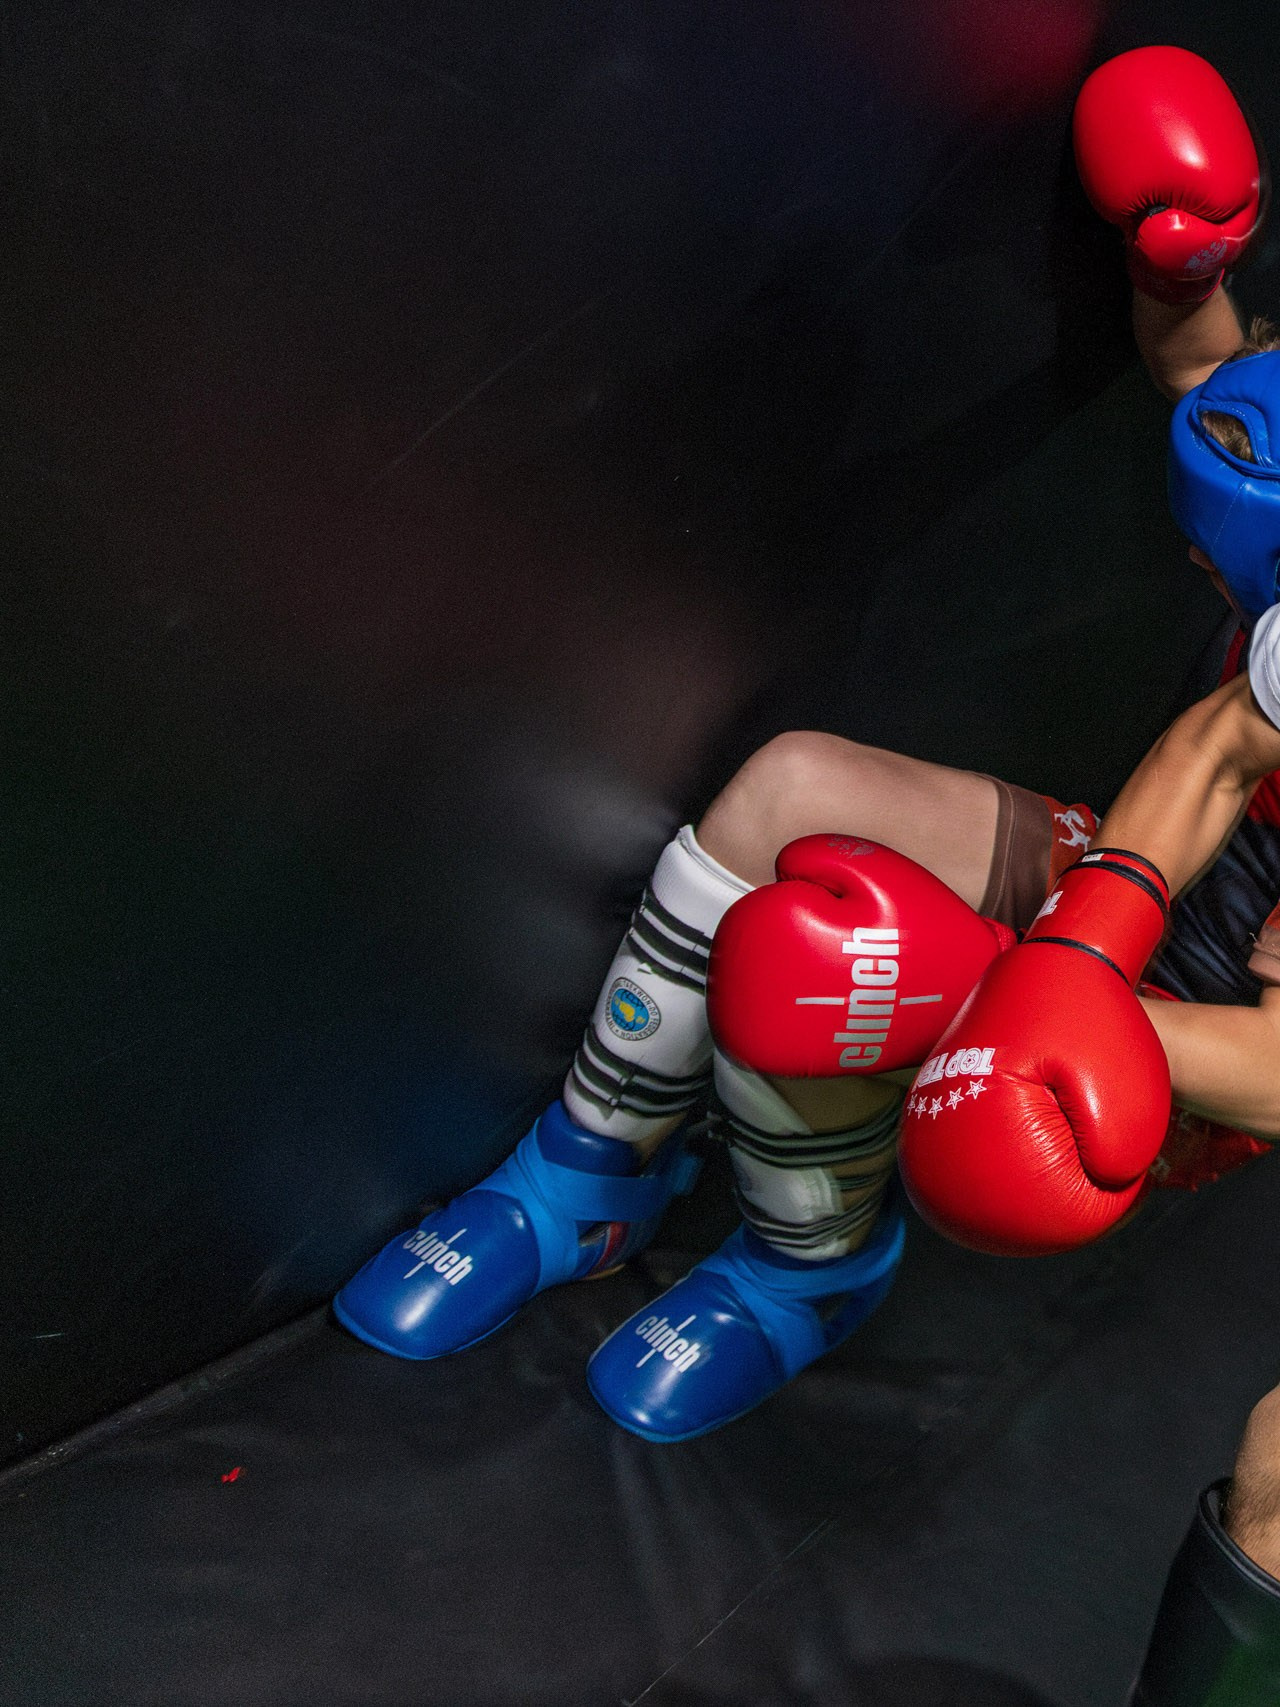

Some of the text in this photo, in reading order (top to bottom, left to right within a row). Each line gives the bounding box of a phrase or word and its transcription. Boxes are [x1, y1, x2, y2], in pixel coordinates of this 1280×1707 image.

[833, 927, 900, 1068] clinch
[911, 1047, 996, 1094] TOP TE
[402, 1230, 473, 1286] clinch
[635, 1316, 700, 1372] clinch
